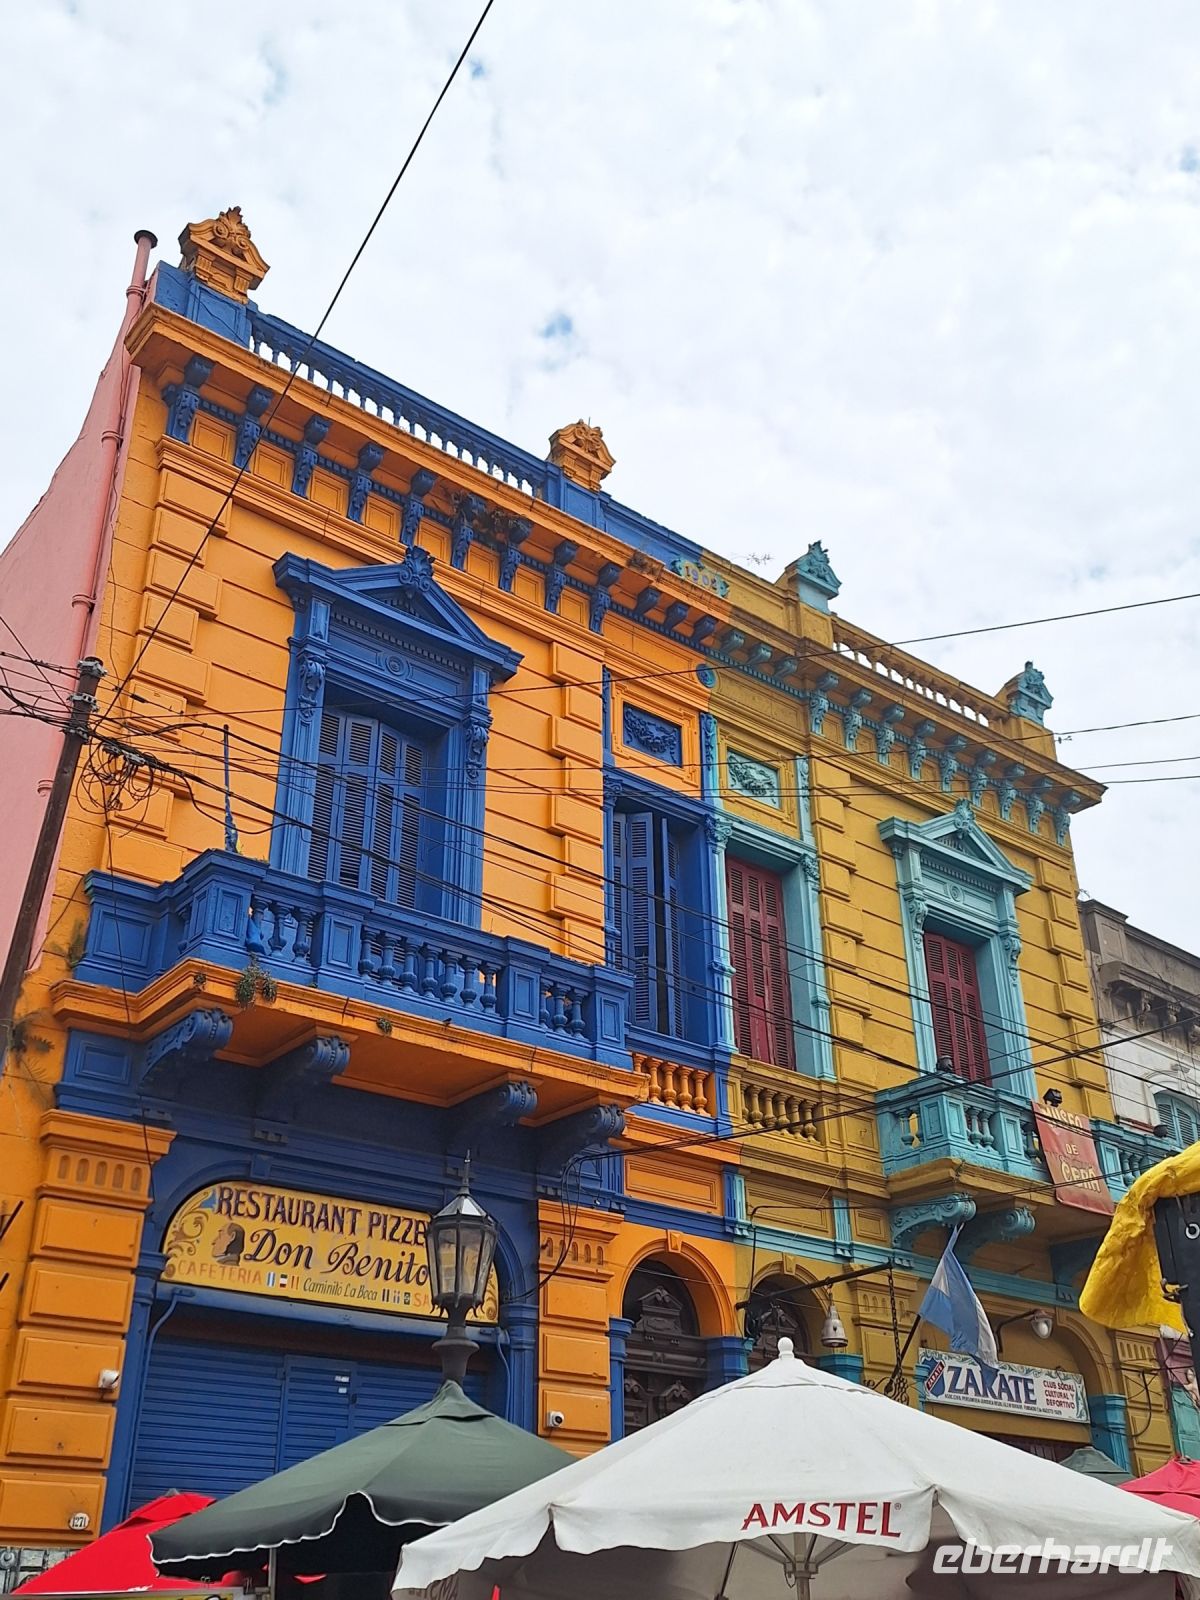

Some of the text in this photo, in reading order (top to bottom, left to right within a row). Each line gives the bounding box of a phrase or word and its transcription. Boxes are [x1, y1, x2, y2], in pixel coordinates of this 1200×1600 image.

[1066, 1143, 1079, 1155] DE
[215, 1186, 428, 1248] RESTAURANT PIZZE
[244, 1228, 429, 1286] Don Benito
[178, 1259, 262, 1285] CAFETERIA
[303, 1277, 378, 1301] Caminito La Boca
[413, 1292, 429, 1308] SA
[1043, 1380, 1075, 1392] CLUB SOCIAL
[1045, 1390, 1069, 1400] CULTURAL
[1046, 1398, 1075, 1409] DEPORTIVO
